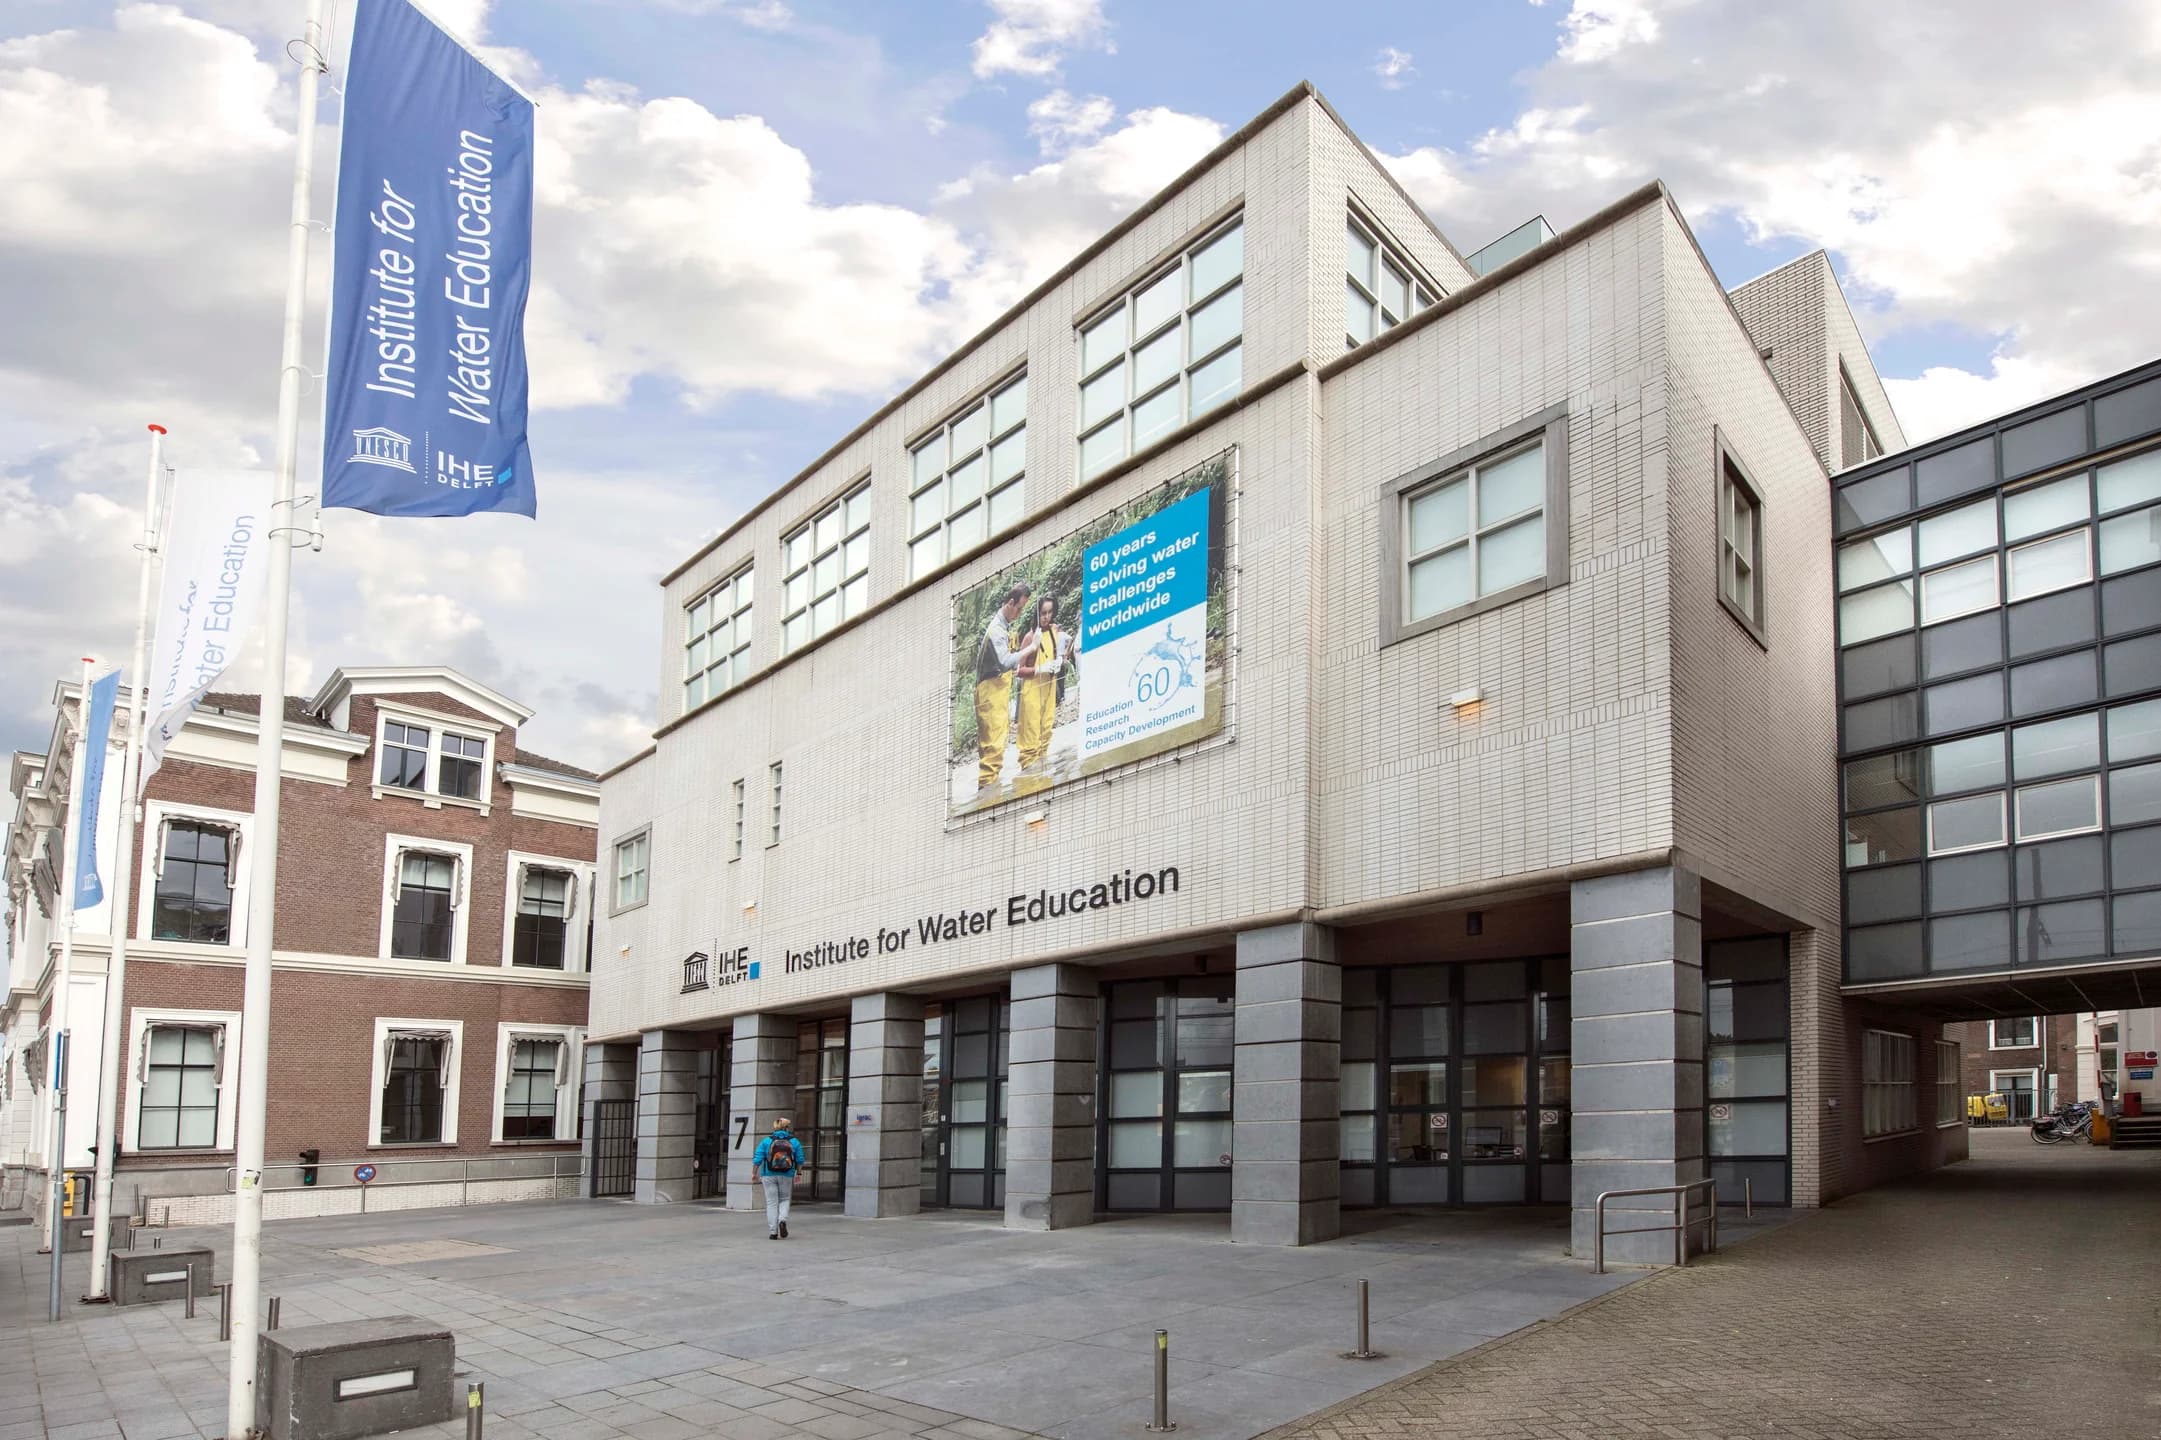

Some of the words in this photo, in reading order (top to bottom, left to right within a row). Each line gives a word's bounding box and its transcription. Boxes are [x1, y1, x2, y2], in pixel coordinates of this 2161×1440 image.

[370, 179, 415, 244] for
[444, 129, 493, 309] Education
[367, 249, 415, 399] Institute
[448, 313, 492, 426] Water
[355, 436, 410, 462] UNESCO
[438, 450, 494, 481] IHE
[437, 473, 494, 489] DELFT
[1090, 552, 1108, 572] 60
[1112, 531, 1156, 566] years
[1090, 557, 1148, 593] solving
[1151, 531, 1200, 564] water
[203, 514, 256, 633] Education
[1089, 567, 1176, 615] challenges
[1088, 592, 1171, 637] worldwide
[1137, 666, 1170, 703] 60
[1085, 714, 1130, 736] Research
[1085, 730, 1126, 750] Capacity
[1128, 704, 1196, 736] Development
[1086, 700, 1134, 722] Education
[785, 937, 870, 974] Institute
[877, 925, 910, 952] for
[917, 904, 998, 945] Water
[1007, 866, 1180, 927] Education
[719, 947, 748, 974] IHE
[719, 972, 748, 986] DELFT
[735, 1116, 749, 1151] 7
